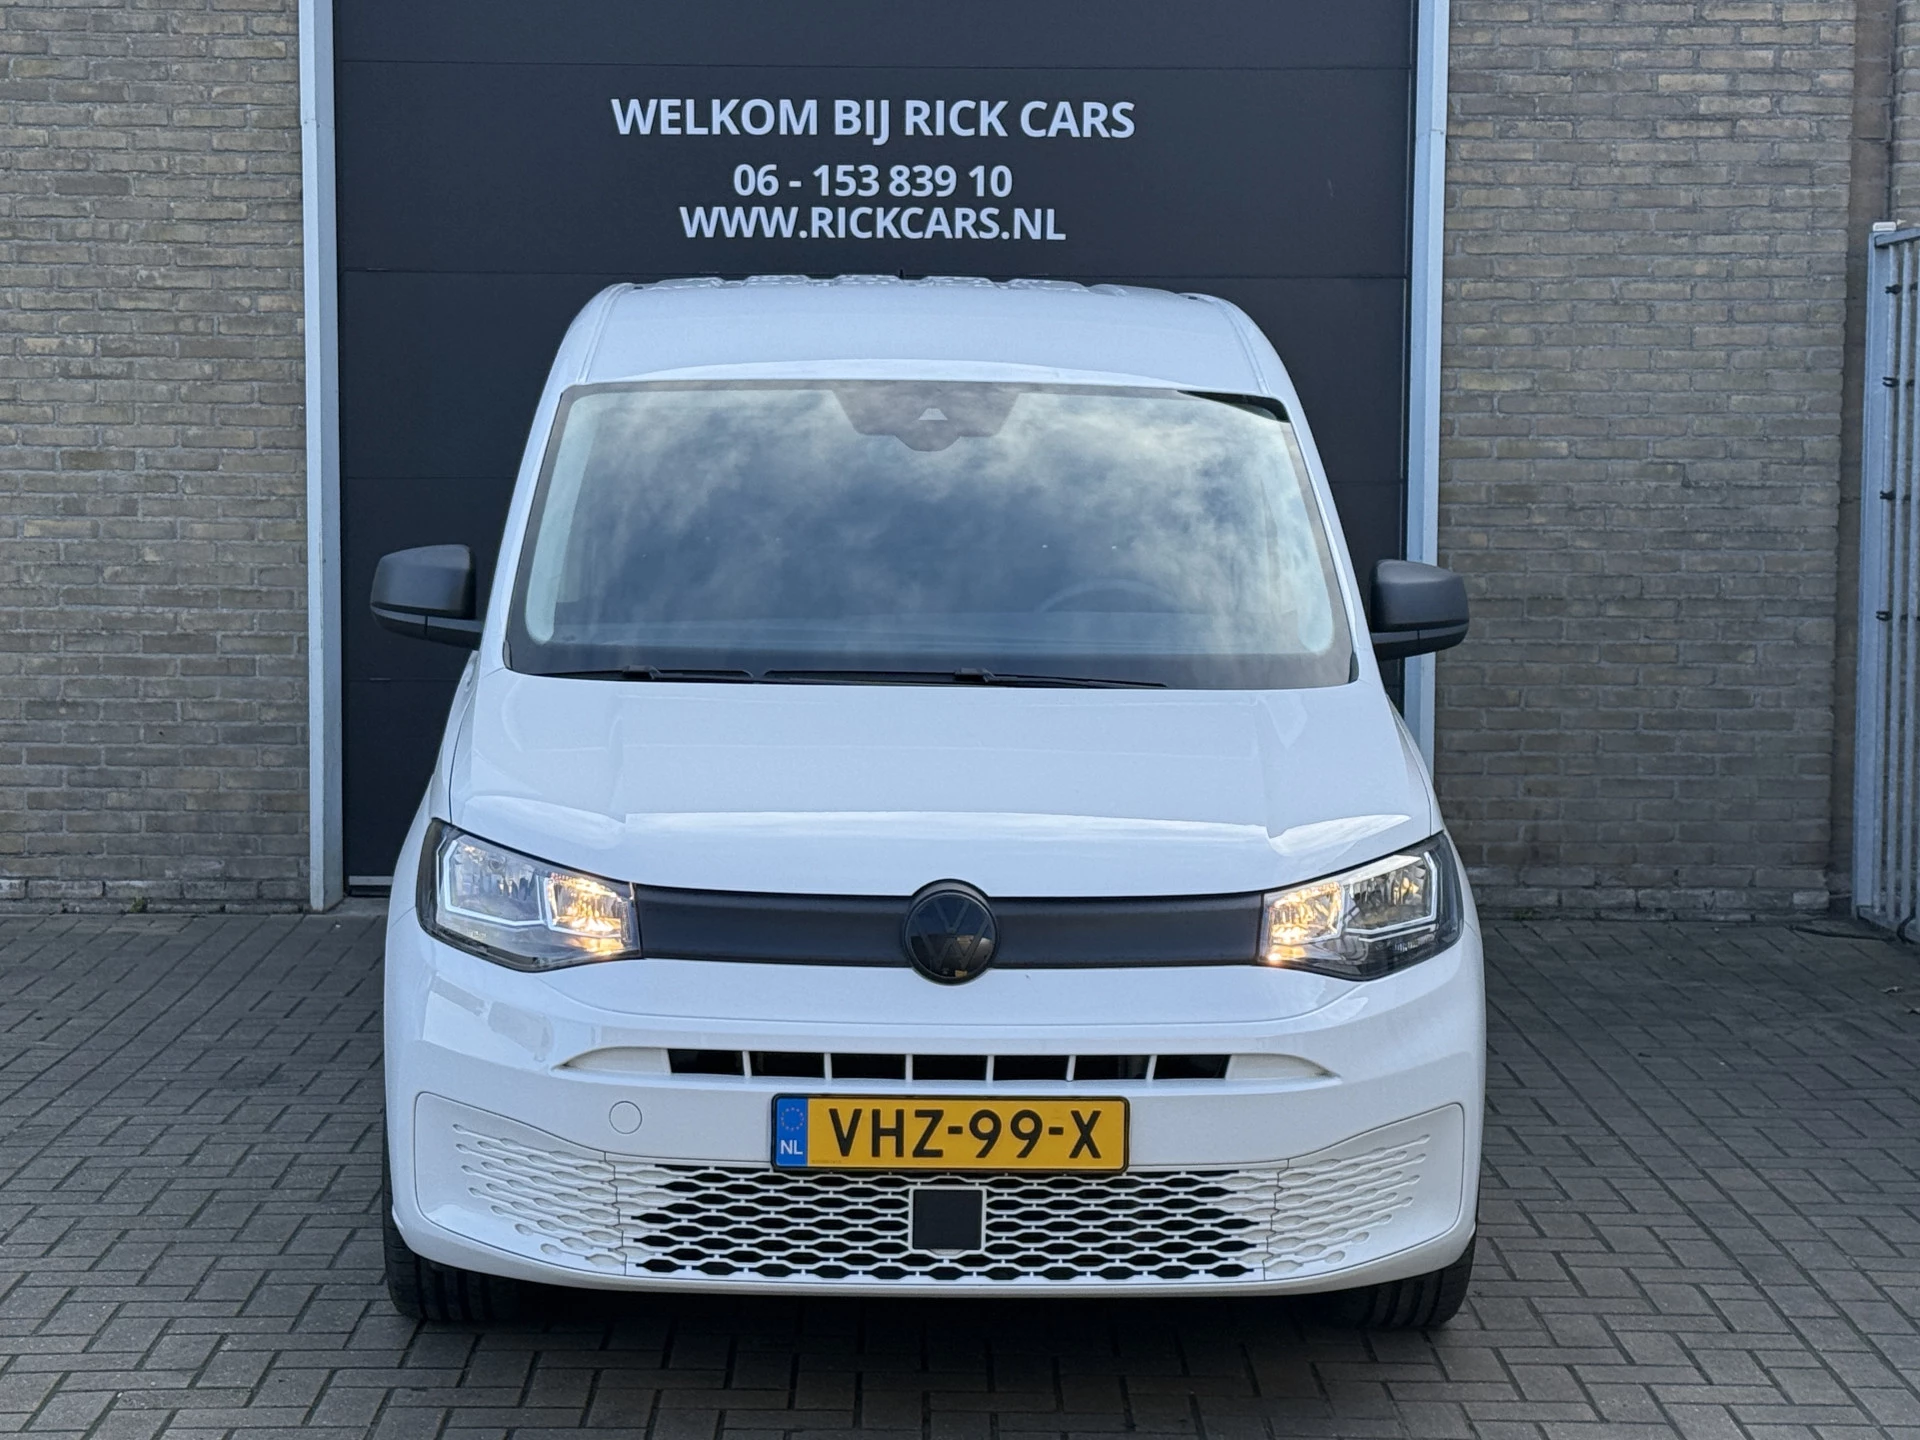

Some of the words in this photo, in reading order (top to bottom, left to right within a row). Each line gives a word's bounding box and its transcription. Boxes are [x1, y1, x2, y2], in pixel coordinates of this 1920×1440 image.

[610, 98, 818, 136] WELKOM
[834, 99, 890, 146] BIJ
[904, 99, 1009, 138] RICK
[1020, 100, 1136, 139] CARS
[733, 163, 779, 197] 06
[788, 180, 802, 188] -
[813, 164, 880, 197] 153
[888, 164, 957, 198] 839
[968, 165, 1013, 198] 10
[679, 206, 1067, 241] WWW.RICKCARS.NL
[780, 1139, 803, 1155] NL
[828, 1107, 1102, 1160] VHZ-99-X
